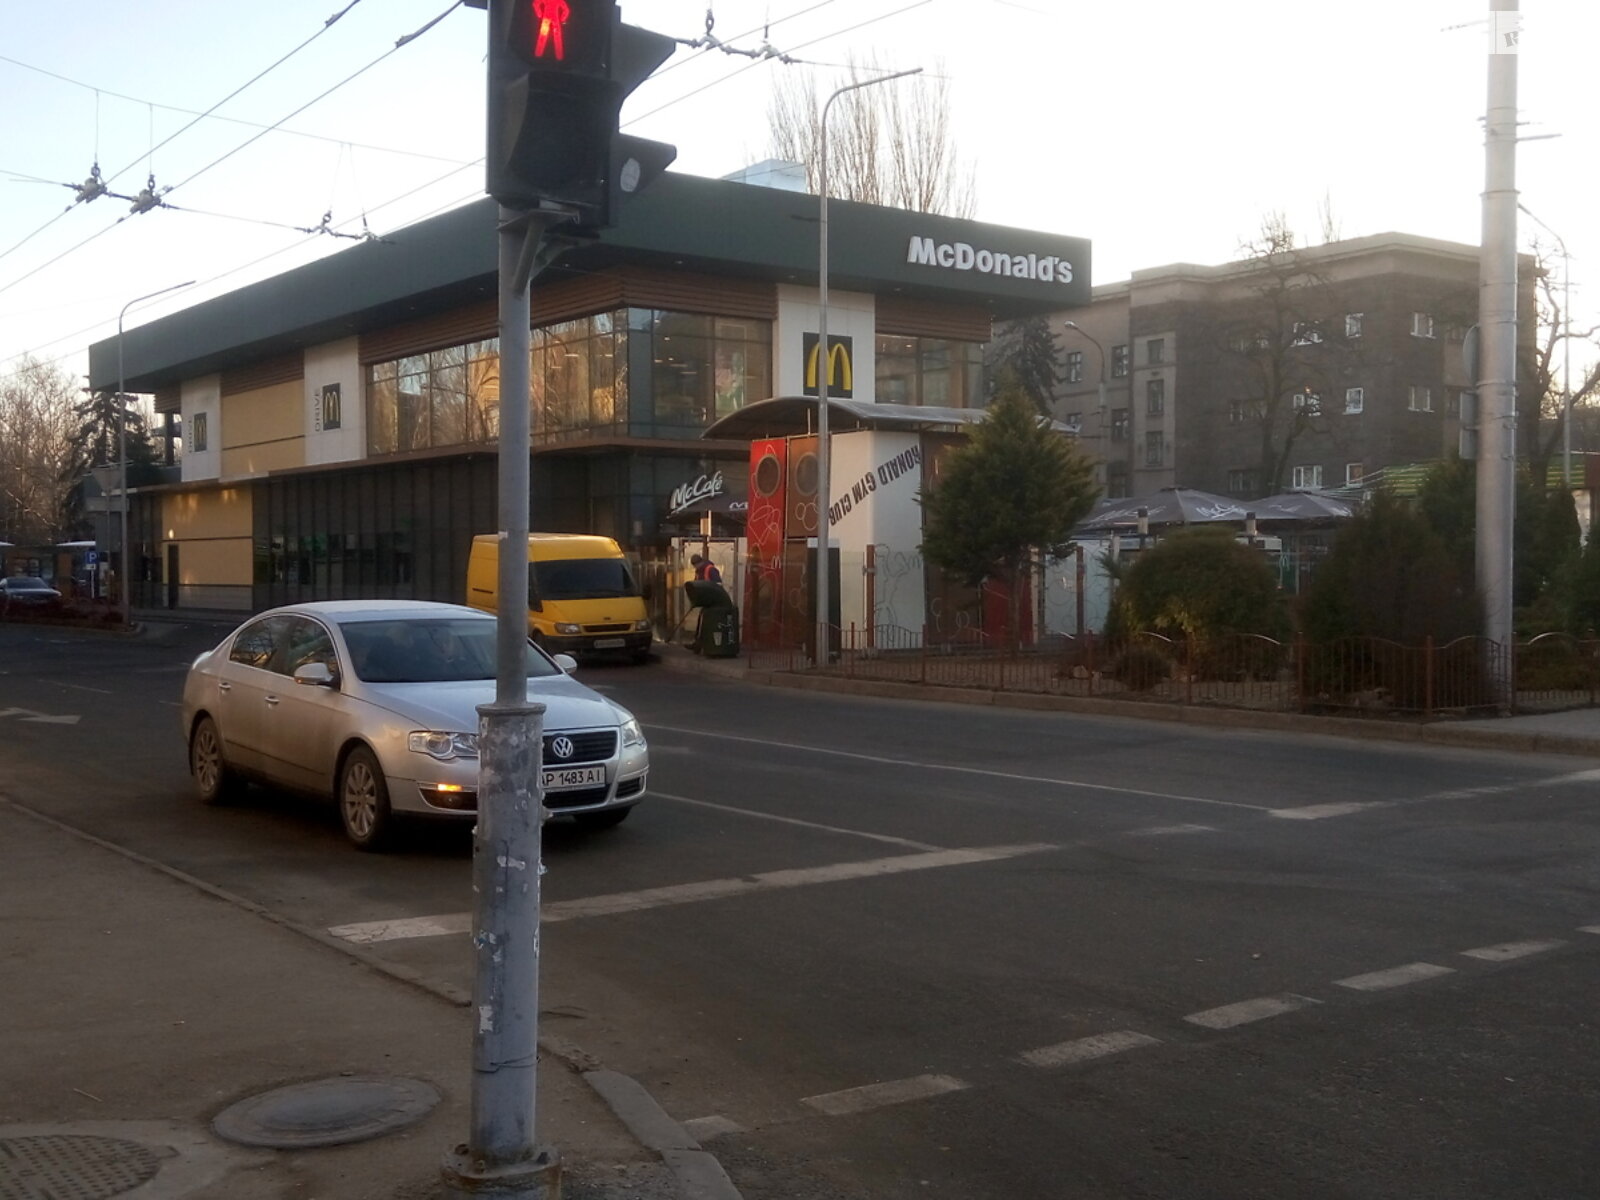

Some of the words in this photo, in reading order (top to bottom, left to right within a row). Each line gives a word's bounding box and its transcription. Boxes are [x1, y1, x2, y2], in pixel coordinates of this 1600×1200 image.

[907, 235, 1073, 284] McDonald's
[877, 444, 922, 487] RONALD
[851, 471, 878, 505] GYM
[828, 493, 853, 527] CLUB
[558, 770, 584, 786] 1483
